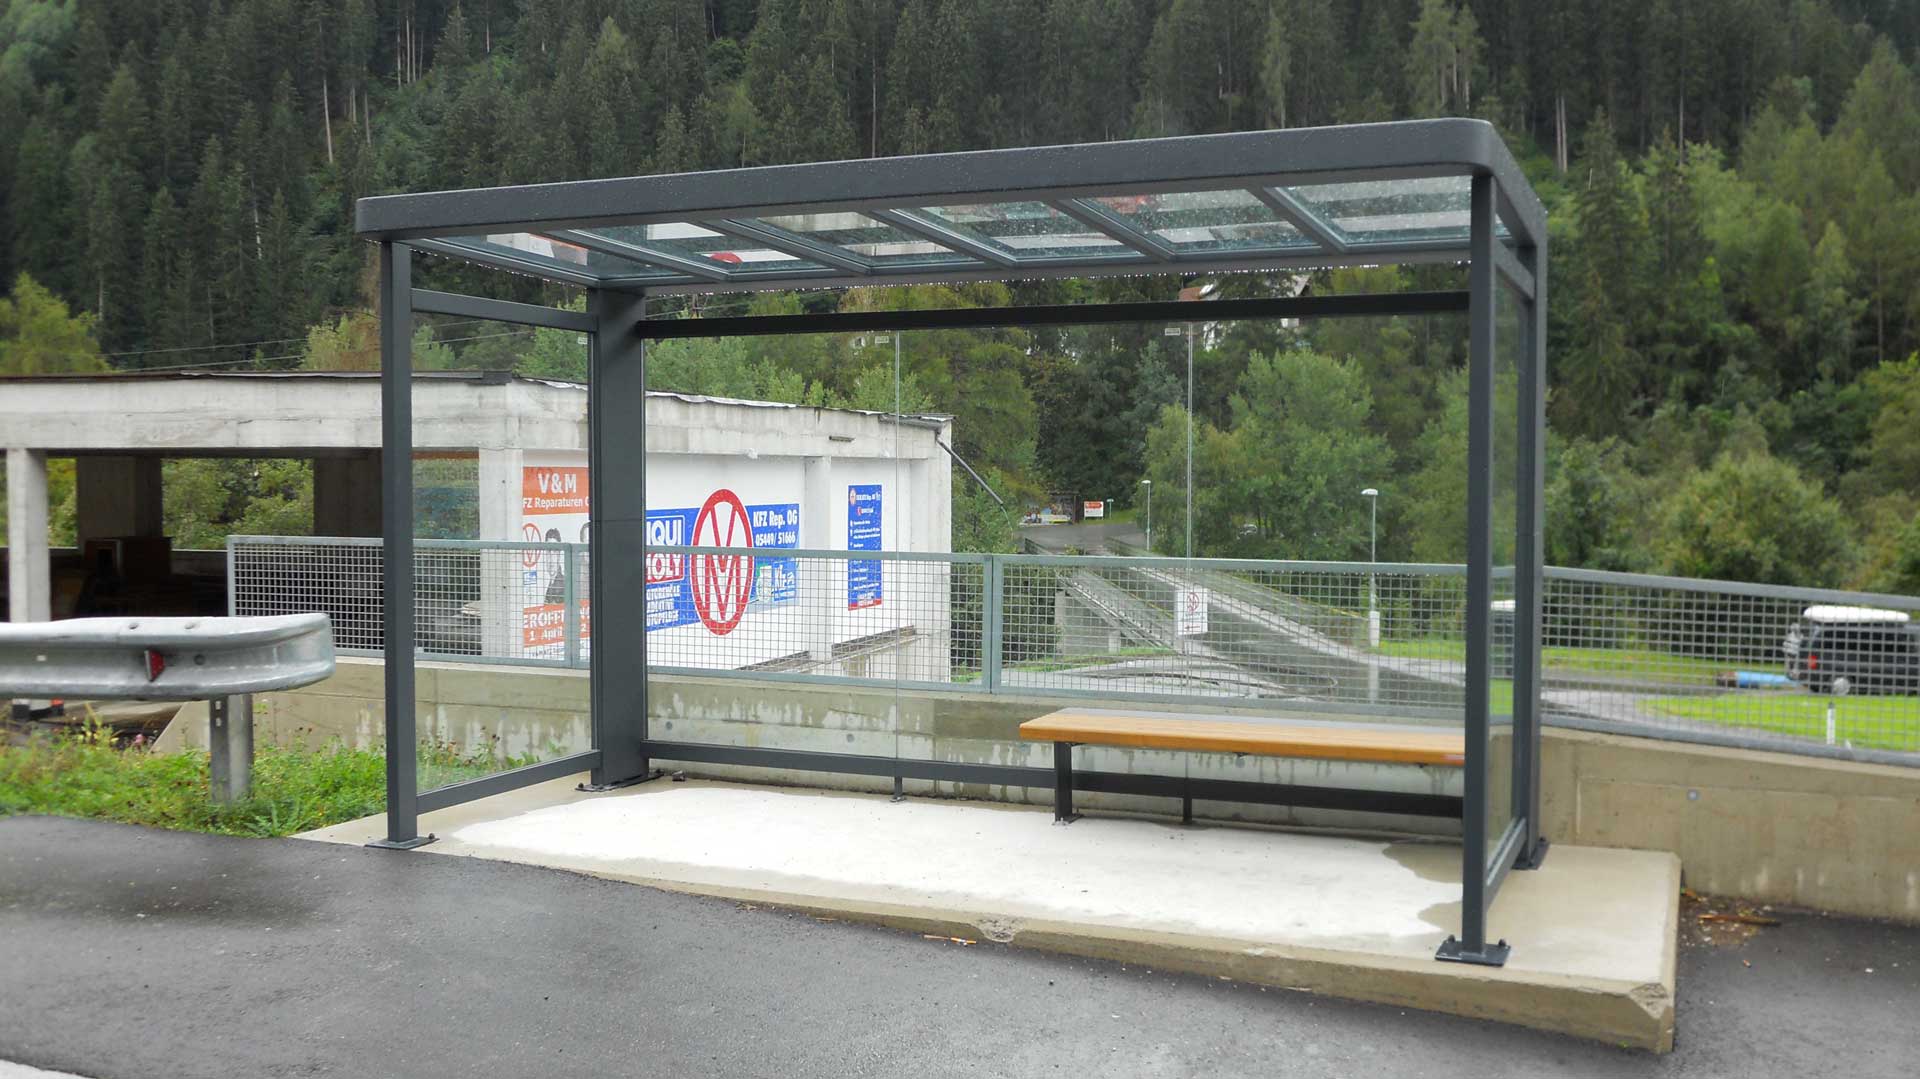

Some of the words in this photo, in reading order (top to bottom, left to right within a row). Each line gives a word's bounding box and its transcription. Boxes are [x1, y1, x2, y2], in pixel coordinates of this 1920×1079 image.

[537, 473, 577, 494] V&M
[523, 497, 533, 508] FZ
[535, 496, 583, 511] Reparaturen
[753, 510, 768, 527] KFZ
[769, 510, 786, 529] Rep.
[787, 509, 798, 525] OG
[646, 519, 682, 546] IQUI
[646, 610, 679, 627] UTOPFLEGE
